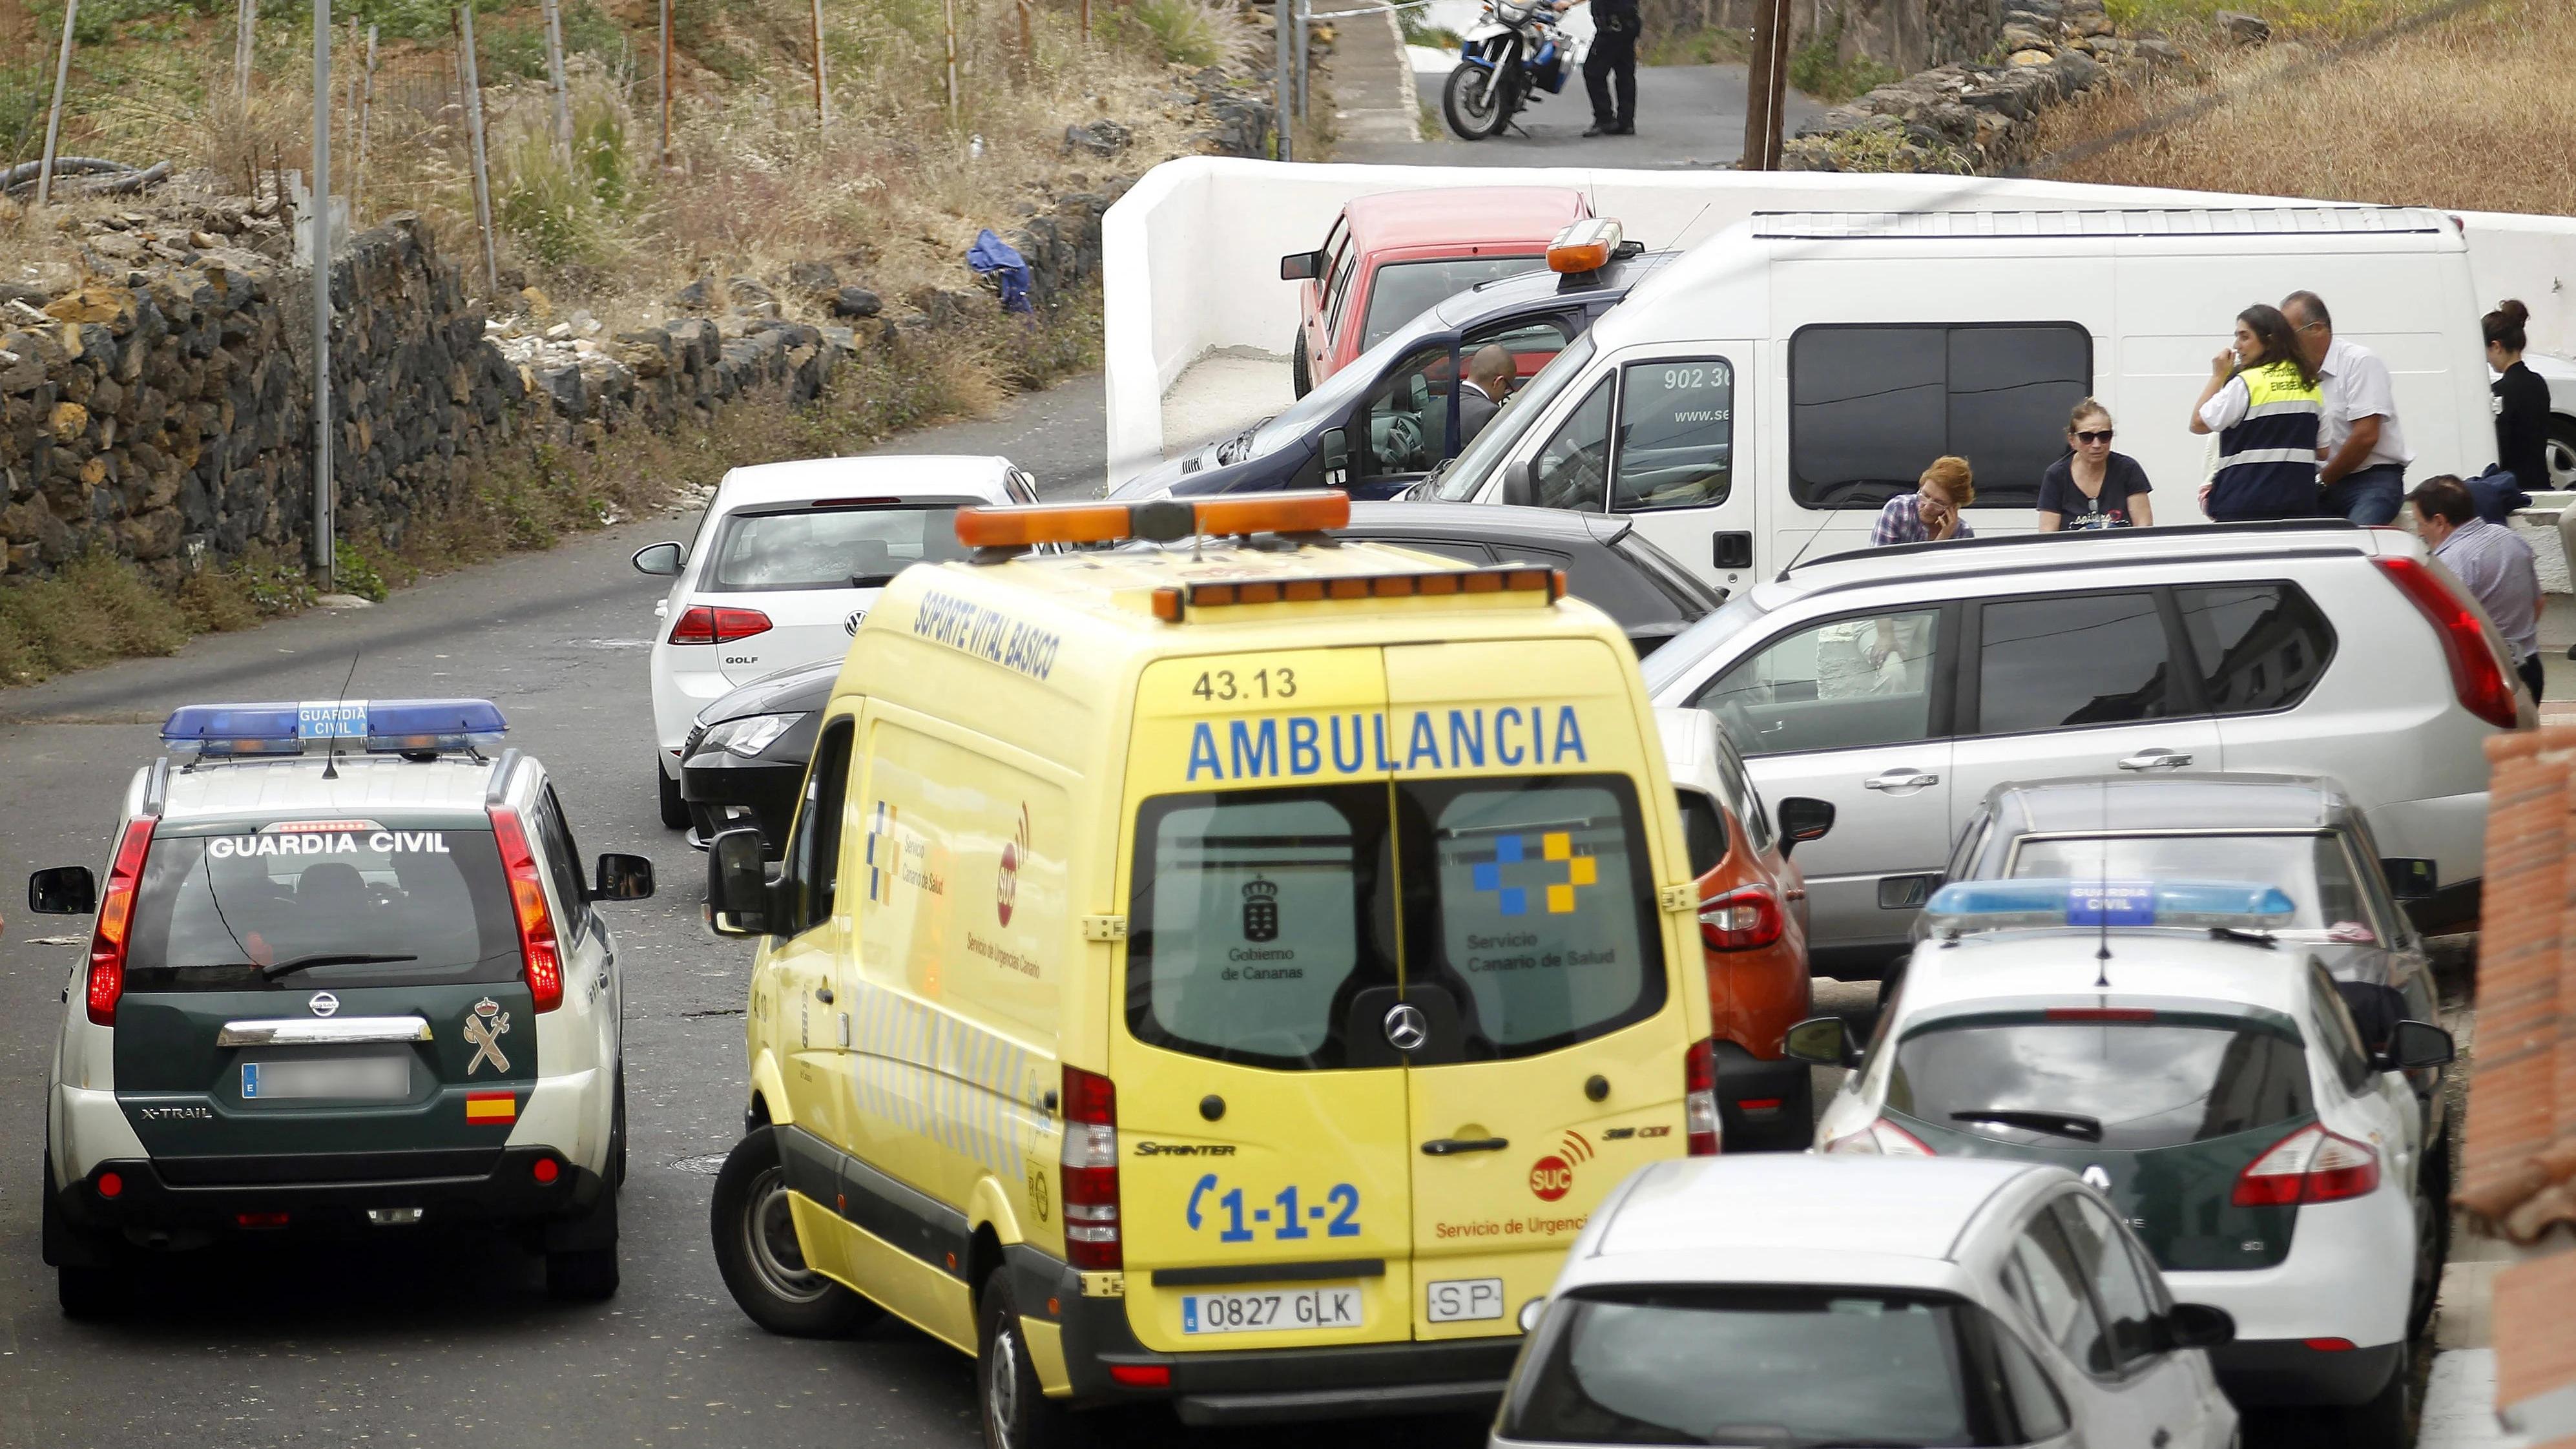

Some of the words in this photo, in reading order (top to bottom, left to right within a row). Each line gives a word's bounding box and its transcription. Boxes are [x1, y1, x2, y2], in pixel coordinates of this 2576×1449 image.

[1665, 368, 1703, 389] 902
[1675, 410, 1729, 422] www.se
[914, 589, 977, 649] SOPORTE
[969, 607, 1010, 662] VITAL
[1004, 621, 1059, 680] BASICO
[1192, 667, 1297, 701] 43.13
[300, 709, 366, 721] GUARDIA
[315, 722, 352, 734] CIVIL
[1187, 705, 1587, 782] AMBULANCIA
[209, 833, 358, 858] GUARDIA
[369, 832, 450, 853] CIVIL
[904, 834, 924, 859] Servicio
[928, 872, 944, 895] Salud
[998, 866, 1016, 908] SUC
[2071, 888, 2148, 897] GUARDIA
[2086, 899, 2132, 910] CIVIL
[967, 932, 987, 957] Servicio
[993, 944, 1019, 969] Urgencias
[1467, 932, 1538, 950] Servicio
[1229, 948, 1294, 961] Gobierno
[1468, 955, 1536, 972] Canario
[1541, 952, 1562, 967] de
[1568, 948, 1615, 965] Salud
[1221, 968, 1239, 981] de
[1243, 966, 1304, 980] Canarias
[141, 1107, 213, 1120] X-TRAIL
[1532, 1170, 1571, 1191] SUC
[1220, 1183, 1360, 1243] 1-1-2
[1437, 1220, 1500, 1238] Servicio
[1504, 1218, 1523, 1235] de
[1529, 1214, 1588, 1235] Urgenci
[1187, 1319, 1194, 1327] E
[1207, 1296, 1282, 1327] 0827
[1295, 1291, 1351, 1326] GLK
